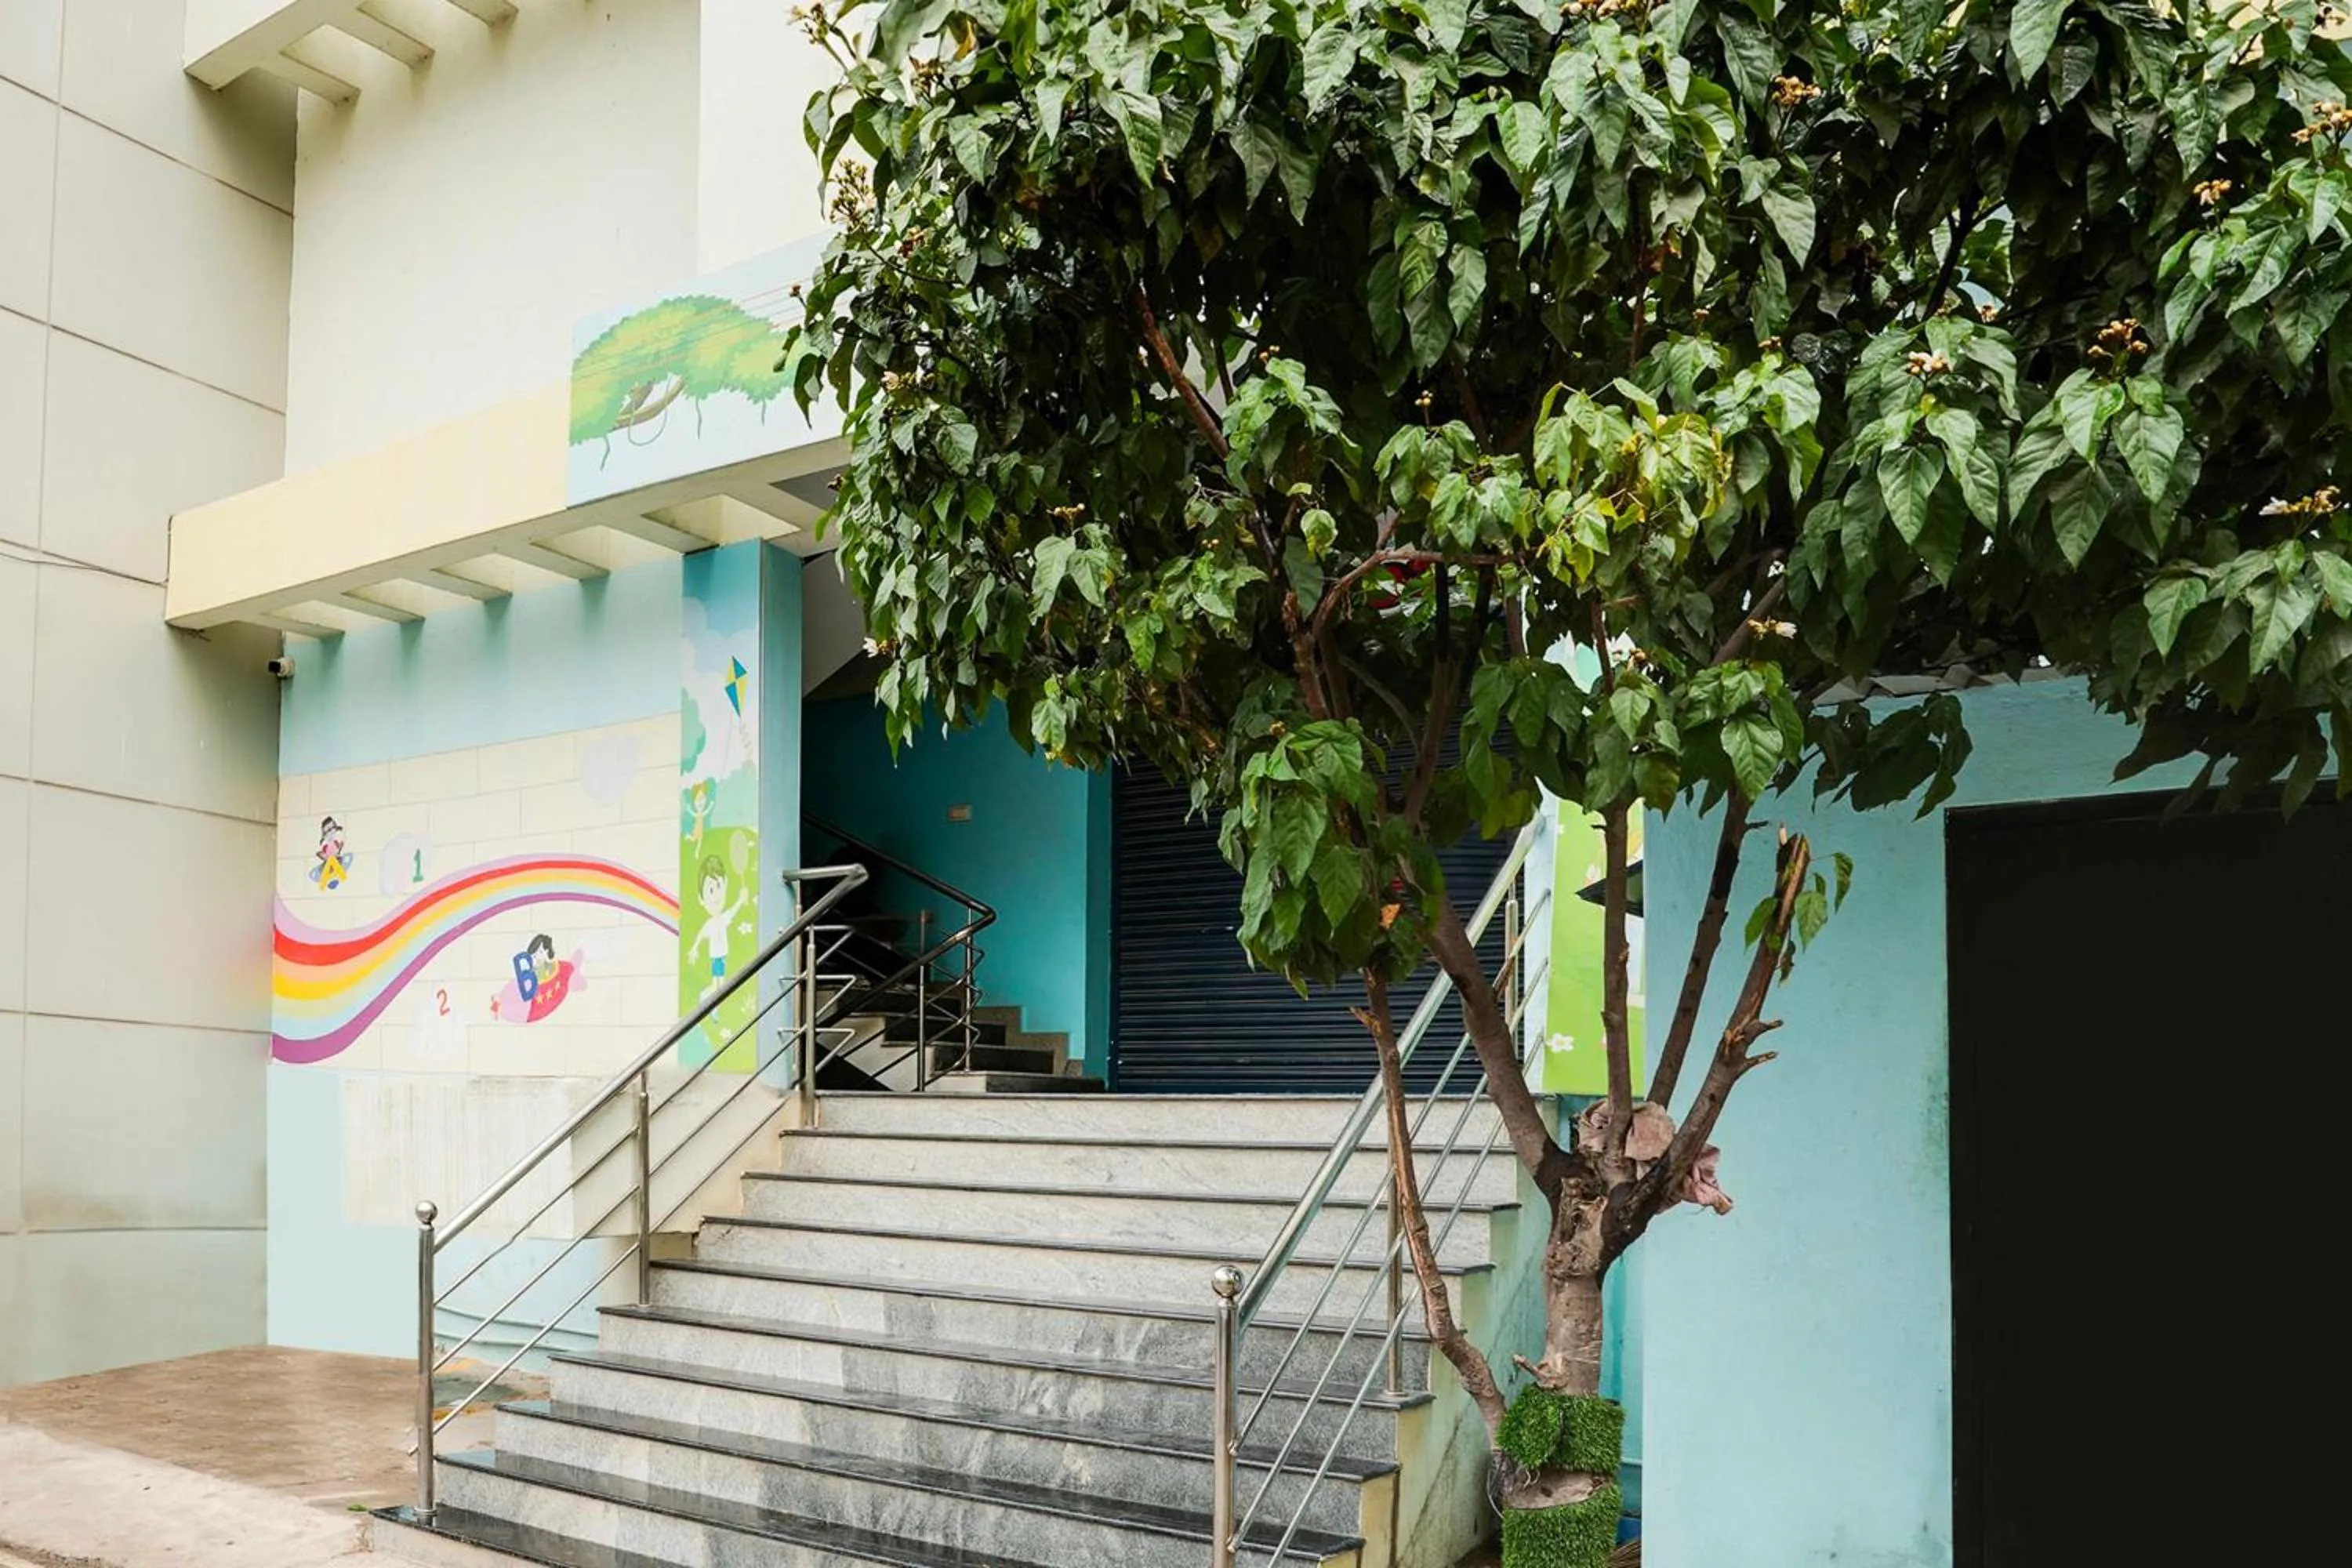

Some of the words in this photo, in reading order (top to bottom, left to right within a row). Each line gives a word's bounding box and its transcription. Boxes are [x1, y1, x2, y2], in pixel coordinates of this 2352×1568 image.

[318, 855, 347, 891] A
[413, 848, 424, 883] 1
[514, 951, 539, 1002] B
[436, 989, 450, 1016] 2
